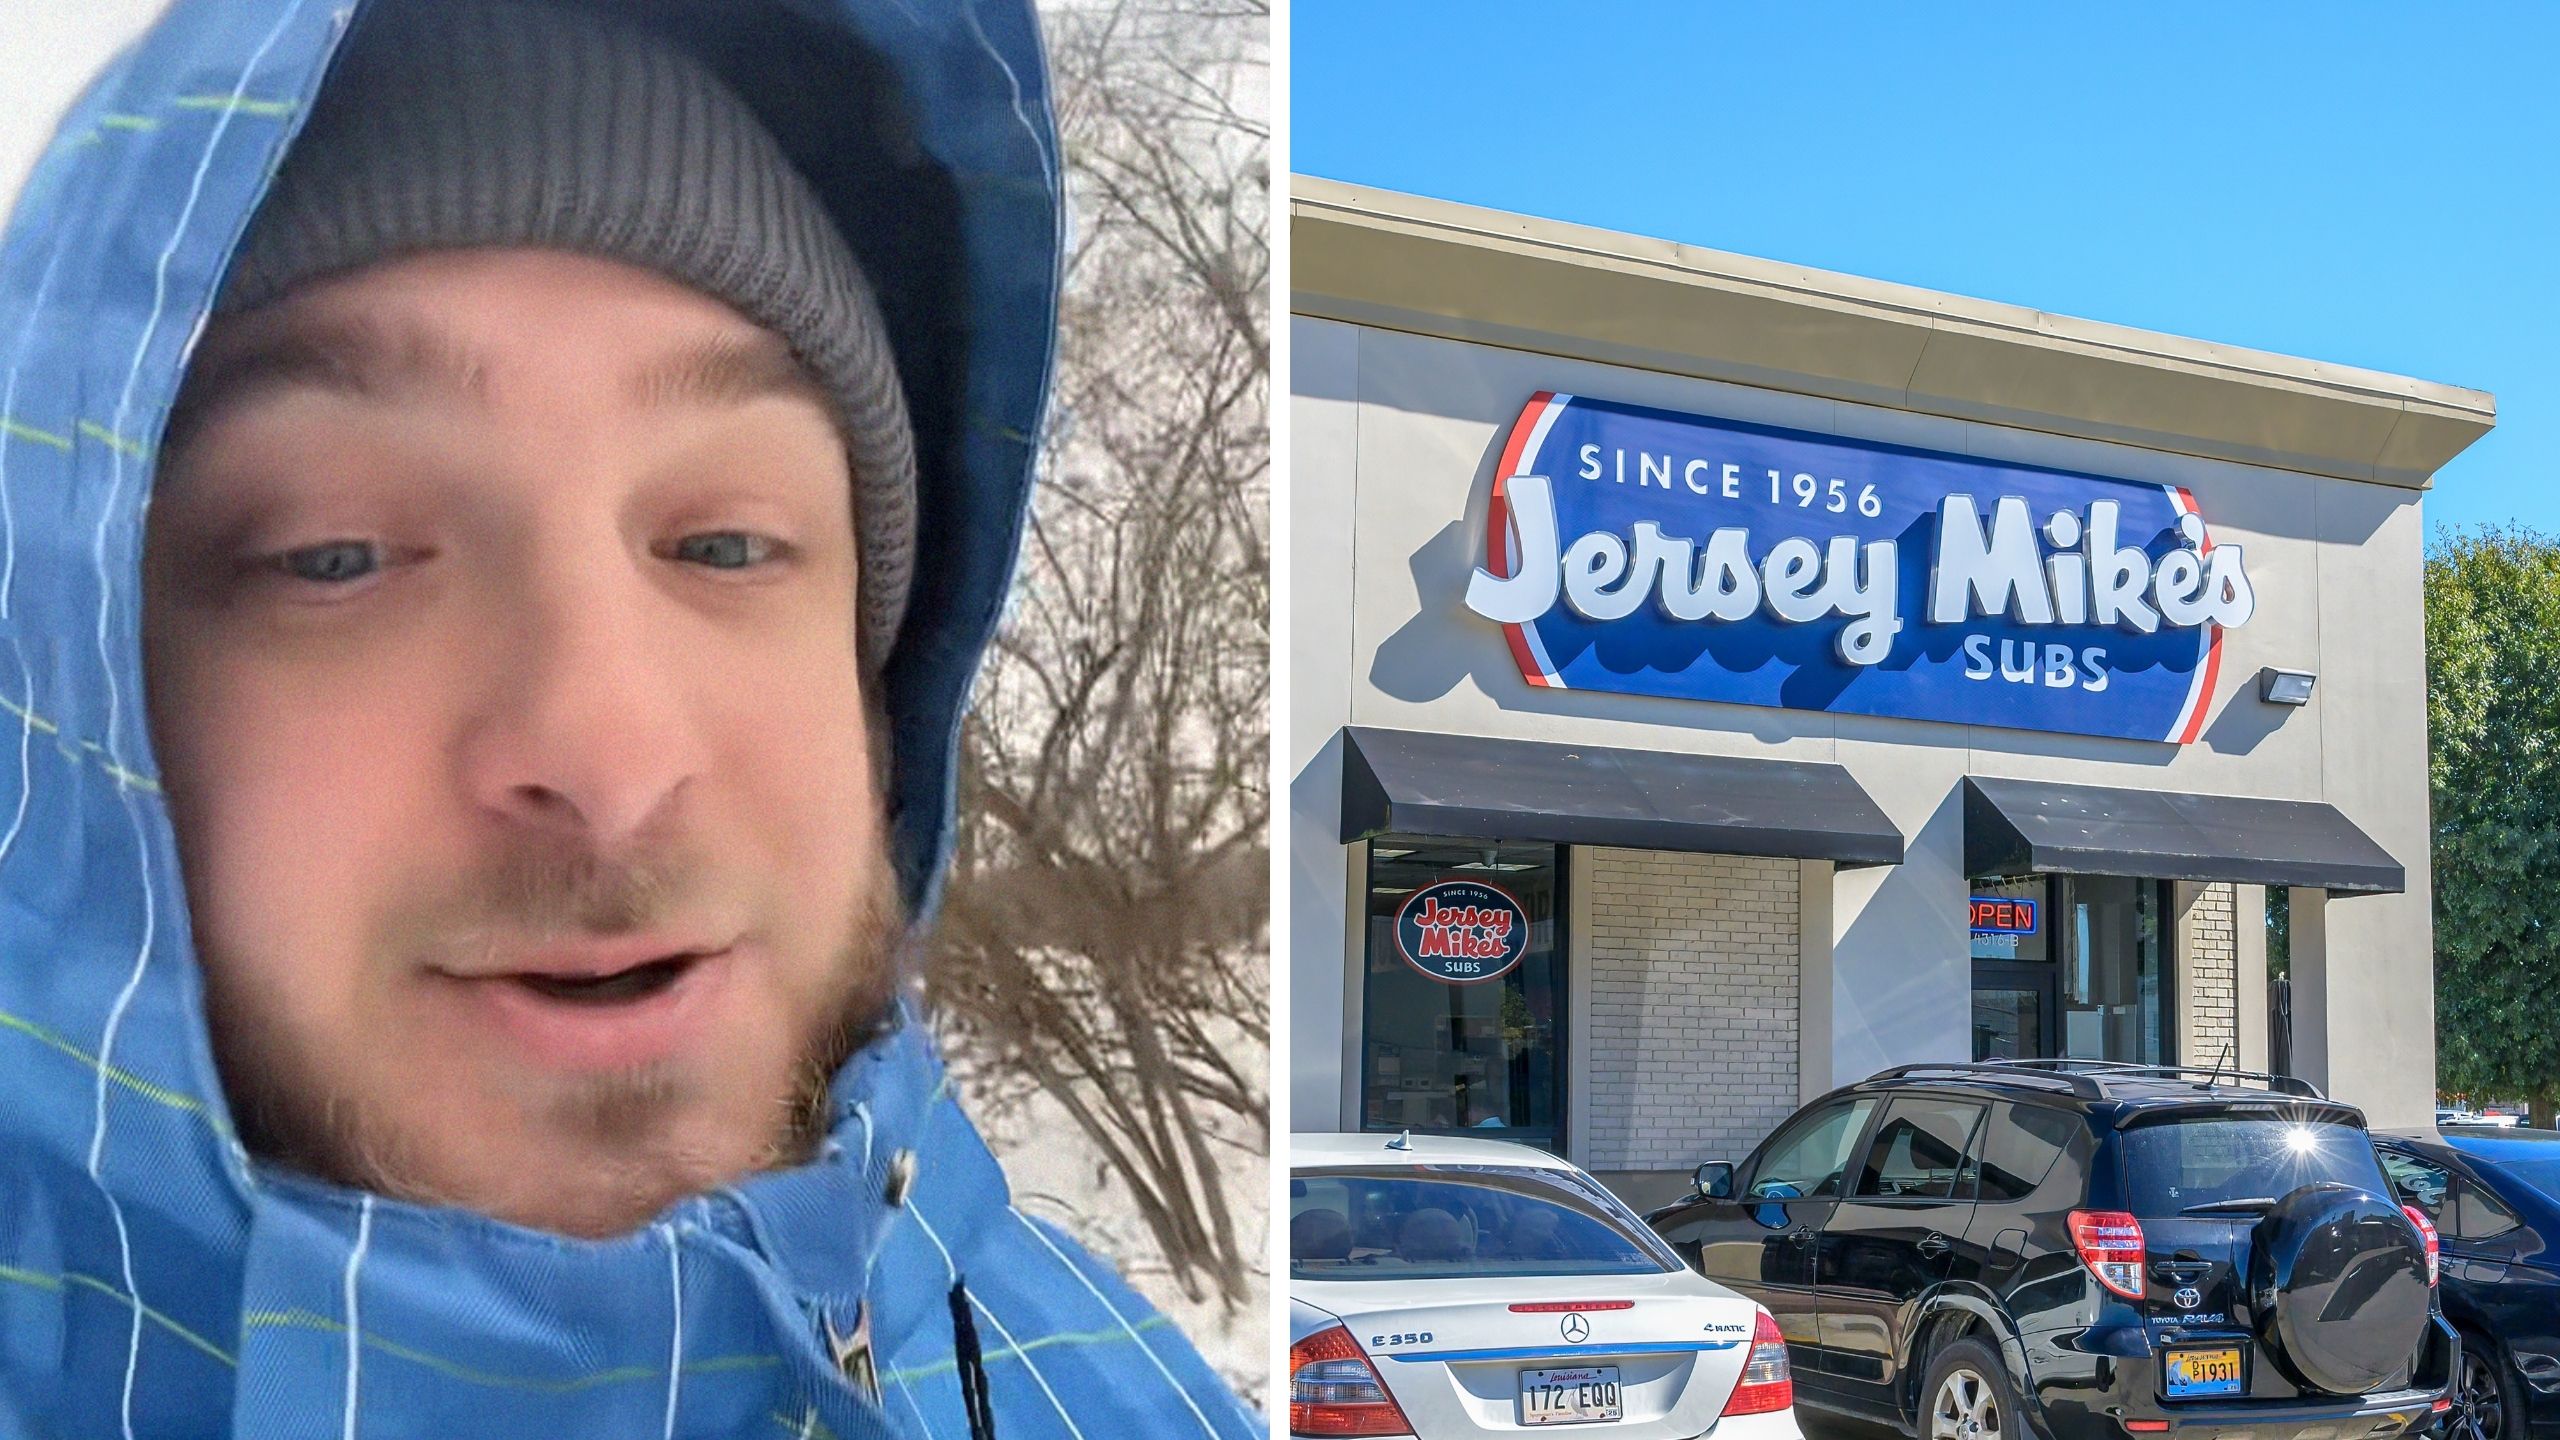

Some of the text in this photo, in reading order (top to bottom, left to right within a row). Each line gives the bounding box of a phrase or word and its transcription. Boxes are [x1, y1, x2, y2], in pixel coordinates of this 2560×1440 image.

[1578, 442, 1882, 518] SINCE 1956
[1465, 474, 2256, 665] Jersey Mike's
[1963, 634, 2110, 692] SUBS
[1442, 889, 1488, 900] SINCE 1956
[1414, 897, 1512, 939] Jersey
[1419, 927, 1511, 959] Mike's
[1445, 961, 1481, 973] SUBS
[2151, 1313, 2225, 1324] TOYOTA RAV4
[1371, 1332, 1433, 1347] E 350
[1549, 1371, 1597, 1382] Louisiana
[2201, 1362, 2234, 1383] 1931
[1529, 1381, 1616, 1411] 172 EQQ
